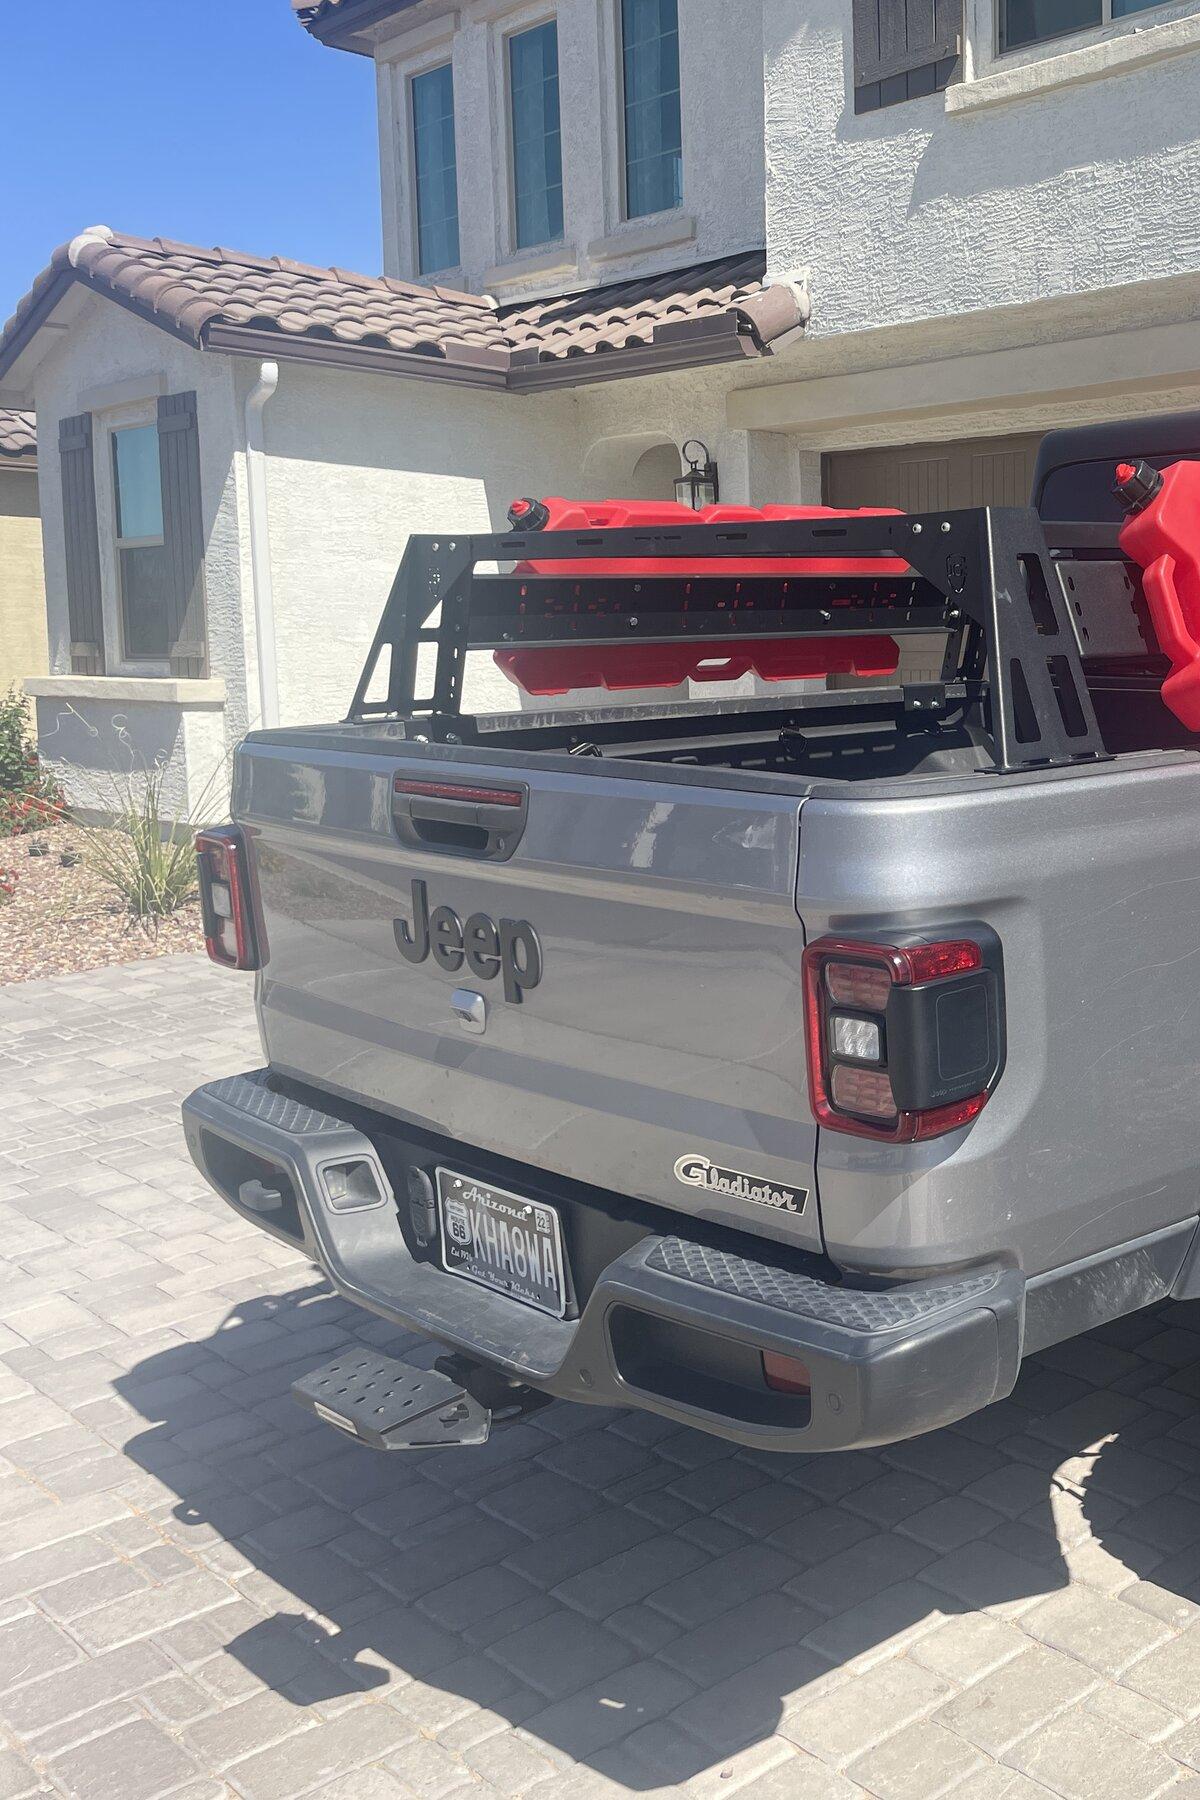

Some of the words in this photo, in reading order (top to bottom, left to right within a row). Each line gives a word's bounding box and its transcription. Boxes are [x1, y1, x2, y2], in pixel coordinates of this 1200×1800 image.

[393, 878, 543, 1004] Jeep
[463, 1187, 528, 1221] Arizona
[674, 1153, 798, 1211] Gladiator
[452, 1221, 466, 1240] 66
[470, 1208, 558, 1291] KHA8WA
[488, 1271, 509, 1287] Your
